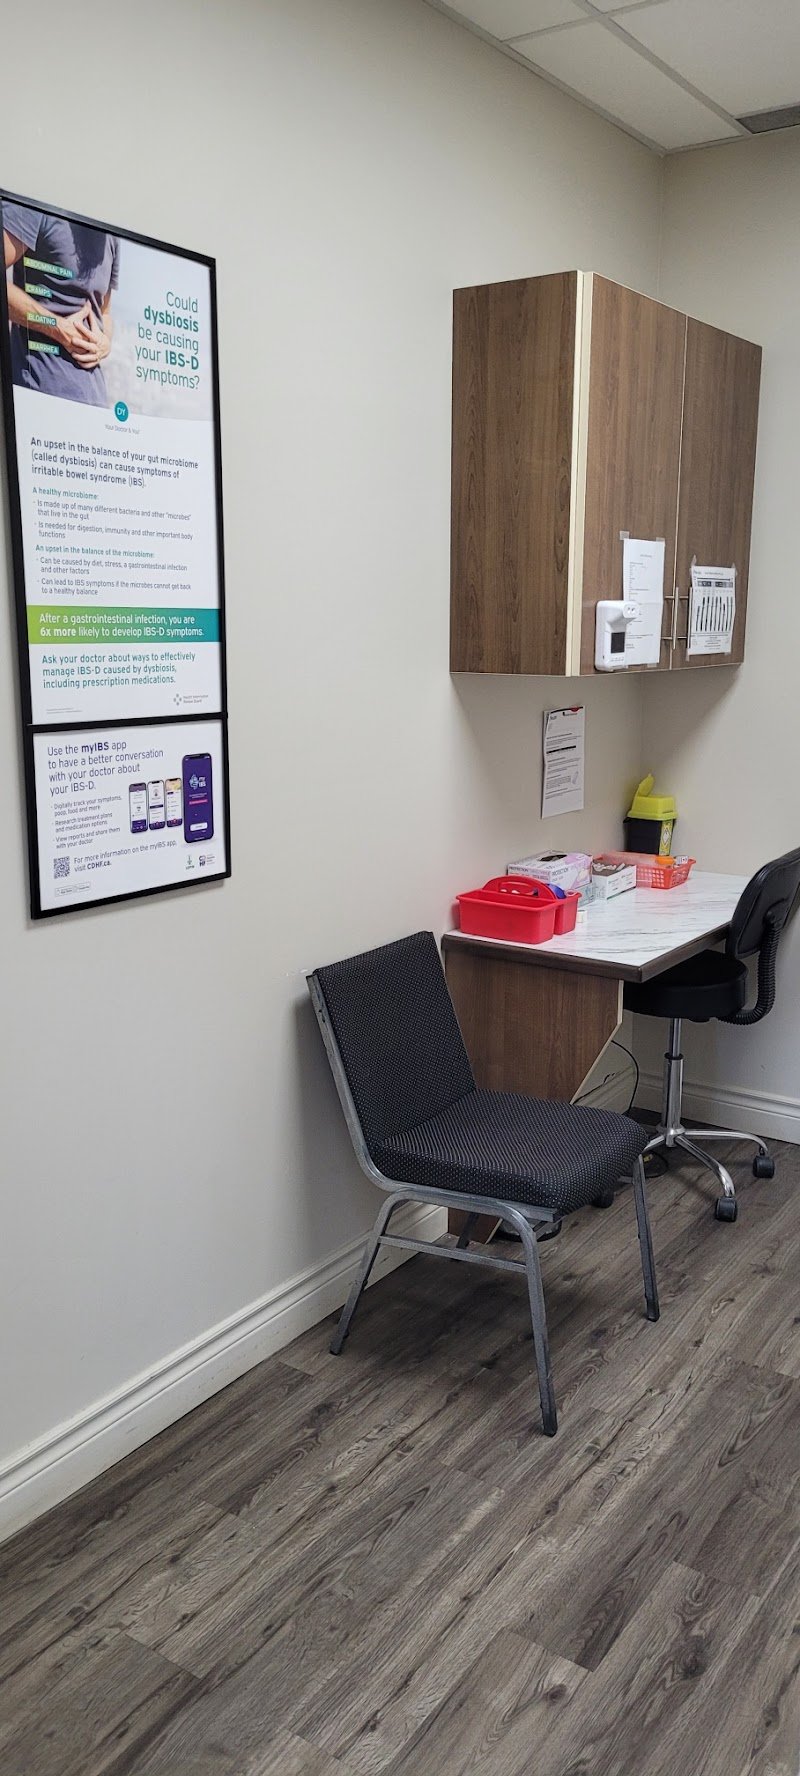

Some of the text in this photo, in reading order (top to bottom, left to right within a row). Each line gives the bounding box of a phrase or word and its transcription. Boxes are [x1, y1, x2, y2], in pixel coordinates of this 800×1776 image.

[60, 268, 73, 278] PAIN
[166, 292, 198, 312] Could
[28, 313, 56, 325] BLOATING
[144, 306, 199, 332] dysbiosis
[138, 323, 199, 355] be causing
[135, 345, 199, 370] your IBS-D
[136, 366, 200, 389] symptoms?
[117, 407, 126, 416] DY
[30, 437, 199, 469] An upset in the balance of your gut microbiome
[31, 449, 180, 478] (called dysbiosis) can cause symptoms of
[31, 465, 64, 477] irritable
[66, 468, 88, 480] bowel
[89, 473, 127, 484] syndrome
[39, 487, 61, 497] healthy
[77, 504, 94, 512] many
[94, 506, 118, 514] different
[118, 507, 140, 516] bacteria
[38, 530, 66, 539] functions
[44, 522, 67, 530] needed
[67, 523, 76, 531] for
[76, 524, 104, 534] digestion,
[105, 526, 131, 536] immunity
[156, 531, 181, 539] important
[81, 547, 104, 555] balance
[61, 558, 83, 566] caused
[128, 562, 166, 570] gastrointestinal
[69, 567, 90, 575] factors
[54, 578, 67, 586] lead
[54, 587, 76, 595] healthy
[39, 613, 61, 623] After
[70, 614, 133, 625] gastrointestinal
[134, 614, 167, 625] infection,
[168, 617, 182, 625] you
[40, 627, 204, 638] 6x more likely to develop IBS-D symptoms.
[41, 654, 58, 664] Ask
[59, 656, 78, 665] your
[80, 654, 106, 663] doctor
[108, 653, 131, 662] about
[132, 654, 150, 663] ways
[160, 652, 196, 662] effectively
[42, 663, 177, 677] manage IBS-D caused by dysbiosis,
[43, 675, 176, 689] including prescription medications.
[47, 741, 127, 756] Use the myIBS app
[48, 760, 57, 769] to
[58, 758, 78, 768] have
[88, 755, 113, 765] better
[115, 749, 164, 762] conversation
[48, 763, 141, 782] with your doctor about
[49, 781, 96, 797] your IBS-D.
[53, 802, 73, 810] Digitally
[100, 848, 132, 858] information
[149, 842, 166, 851] myIBS
[74, 864, 86, 872] visit
